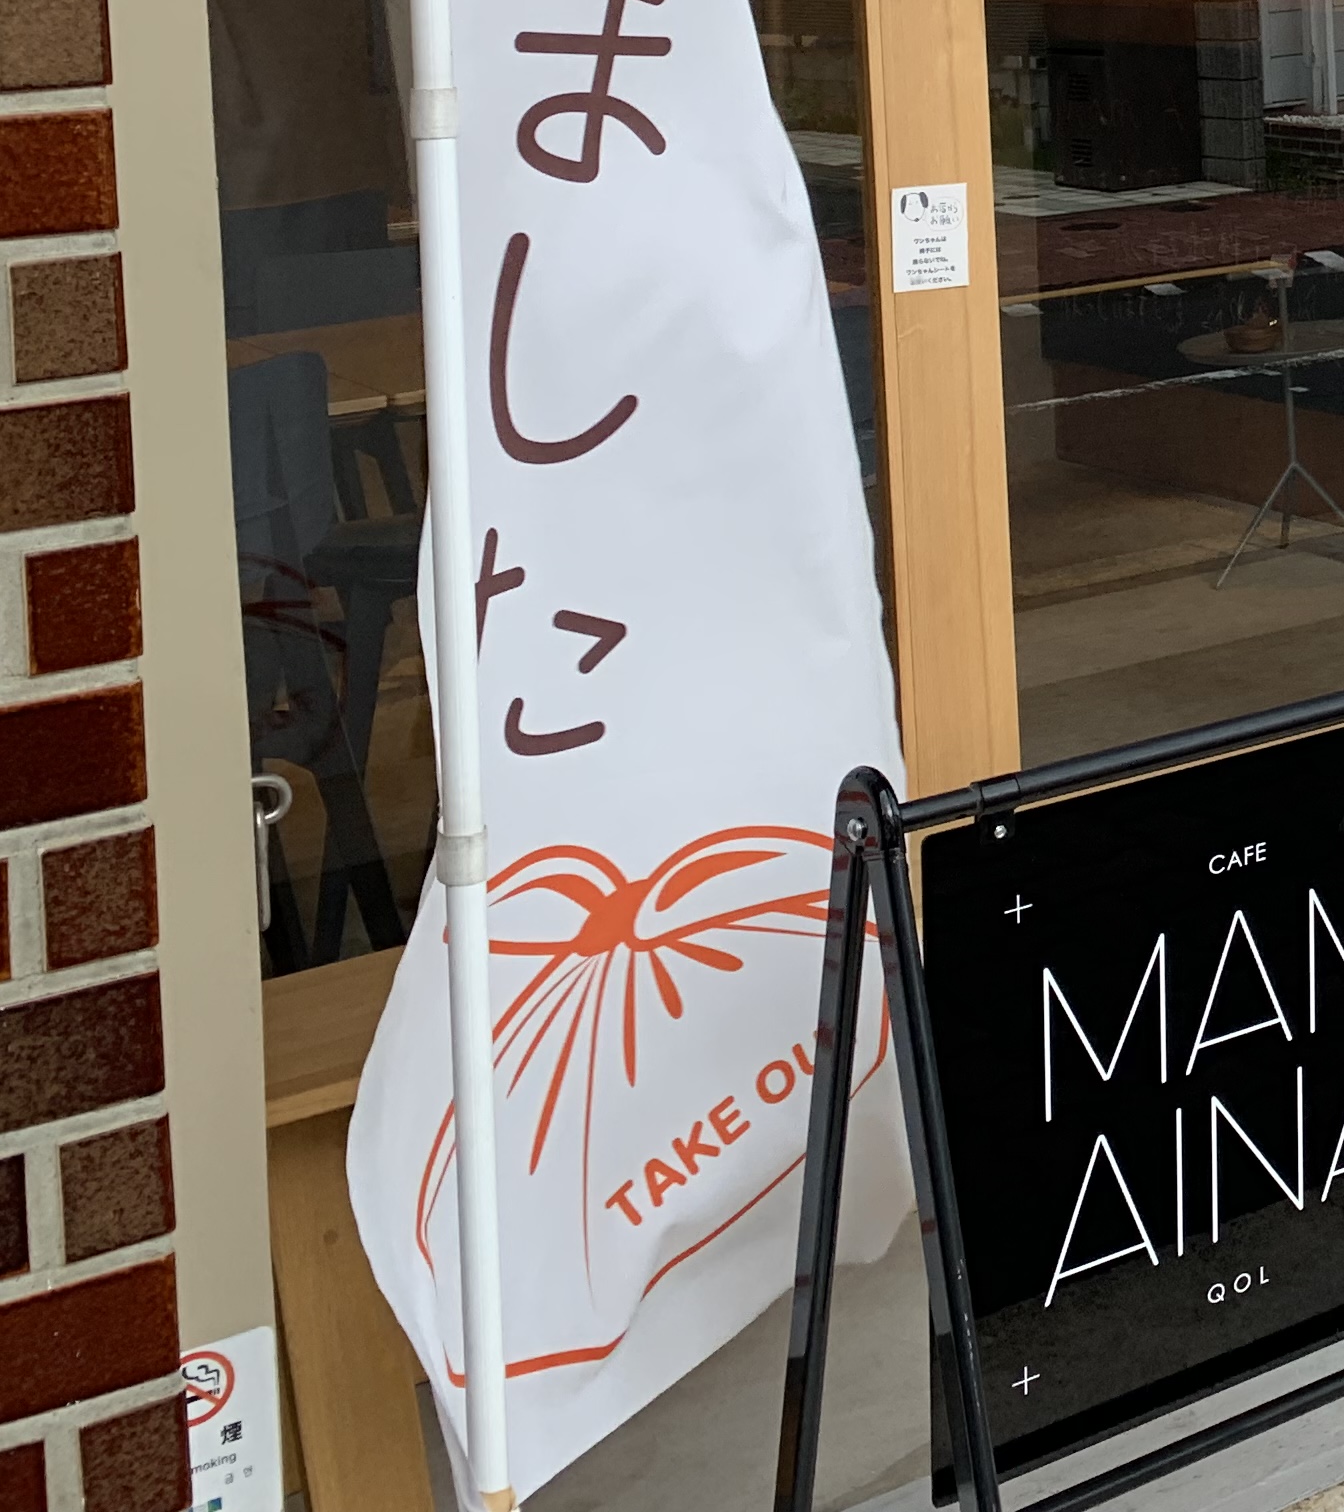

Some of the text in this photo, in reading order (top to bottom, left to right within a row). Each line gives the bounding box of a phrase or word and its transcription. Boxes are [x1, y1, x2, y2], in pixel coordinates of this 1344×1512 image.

[1209, 842, 1268, 876] CAFE
[605, 1030, 817, 1226] TAKE OU
[1207, 1267, 1271, 1304] QOL
[220, 1420, 243, 1445] 煙
[190, 1453, 237, 1475] moking
